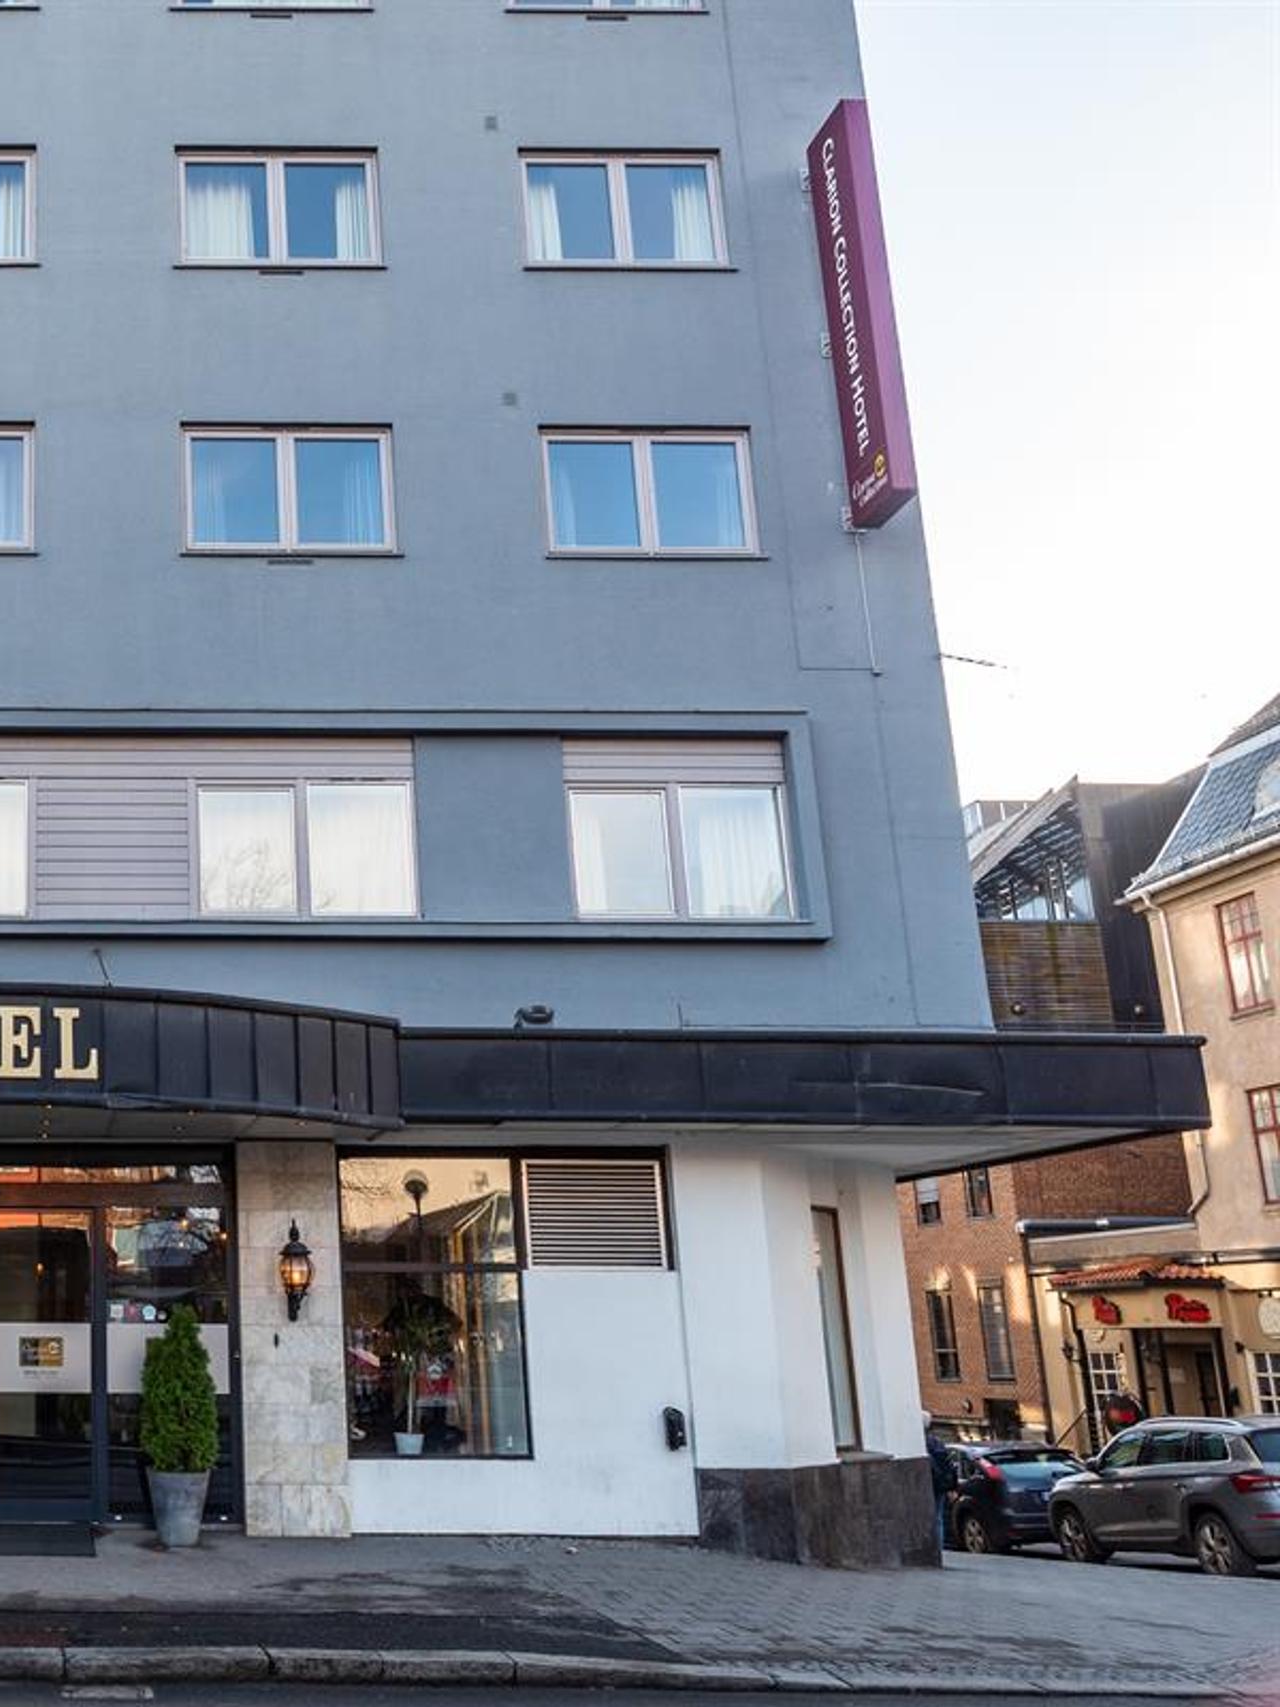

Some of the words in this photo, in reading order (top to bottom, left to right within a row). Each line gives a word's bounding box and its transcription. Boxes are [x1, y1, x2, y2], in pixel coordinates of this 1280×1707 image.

[822, 137, 842, 236] CLARION
[834, 236, 859, 374] COLLECTION
[850, 375, 870, 457] HOTEL
